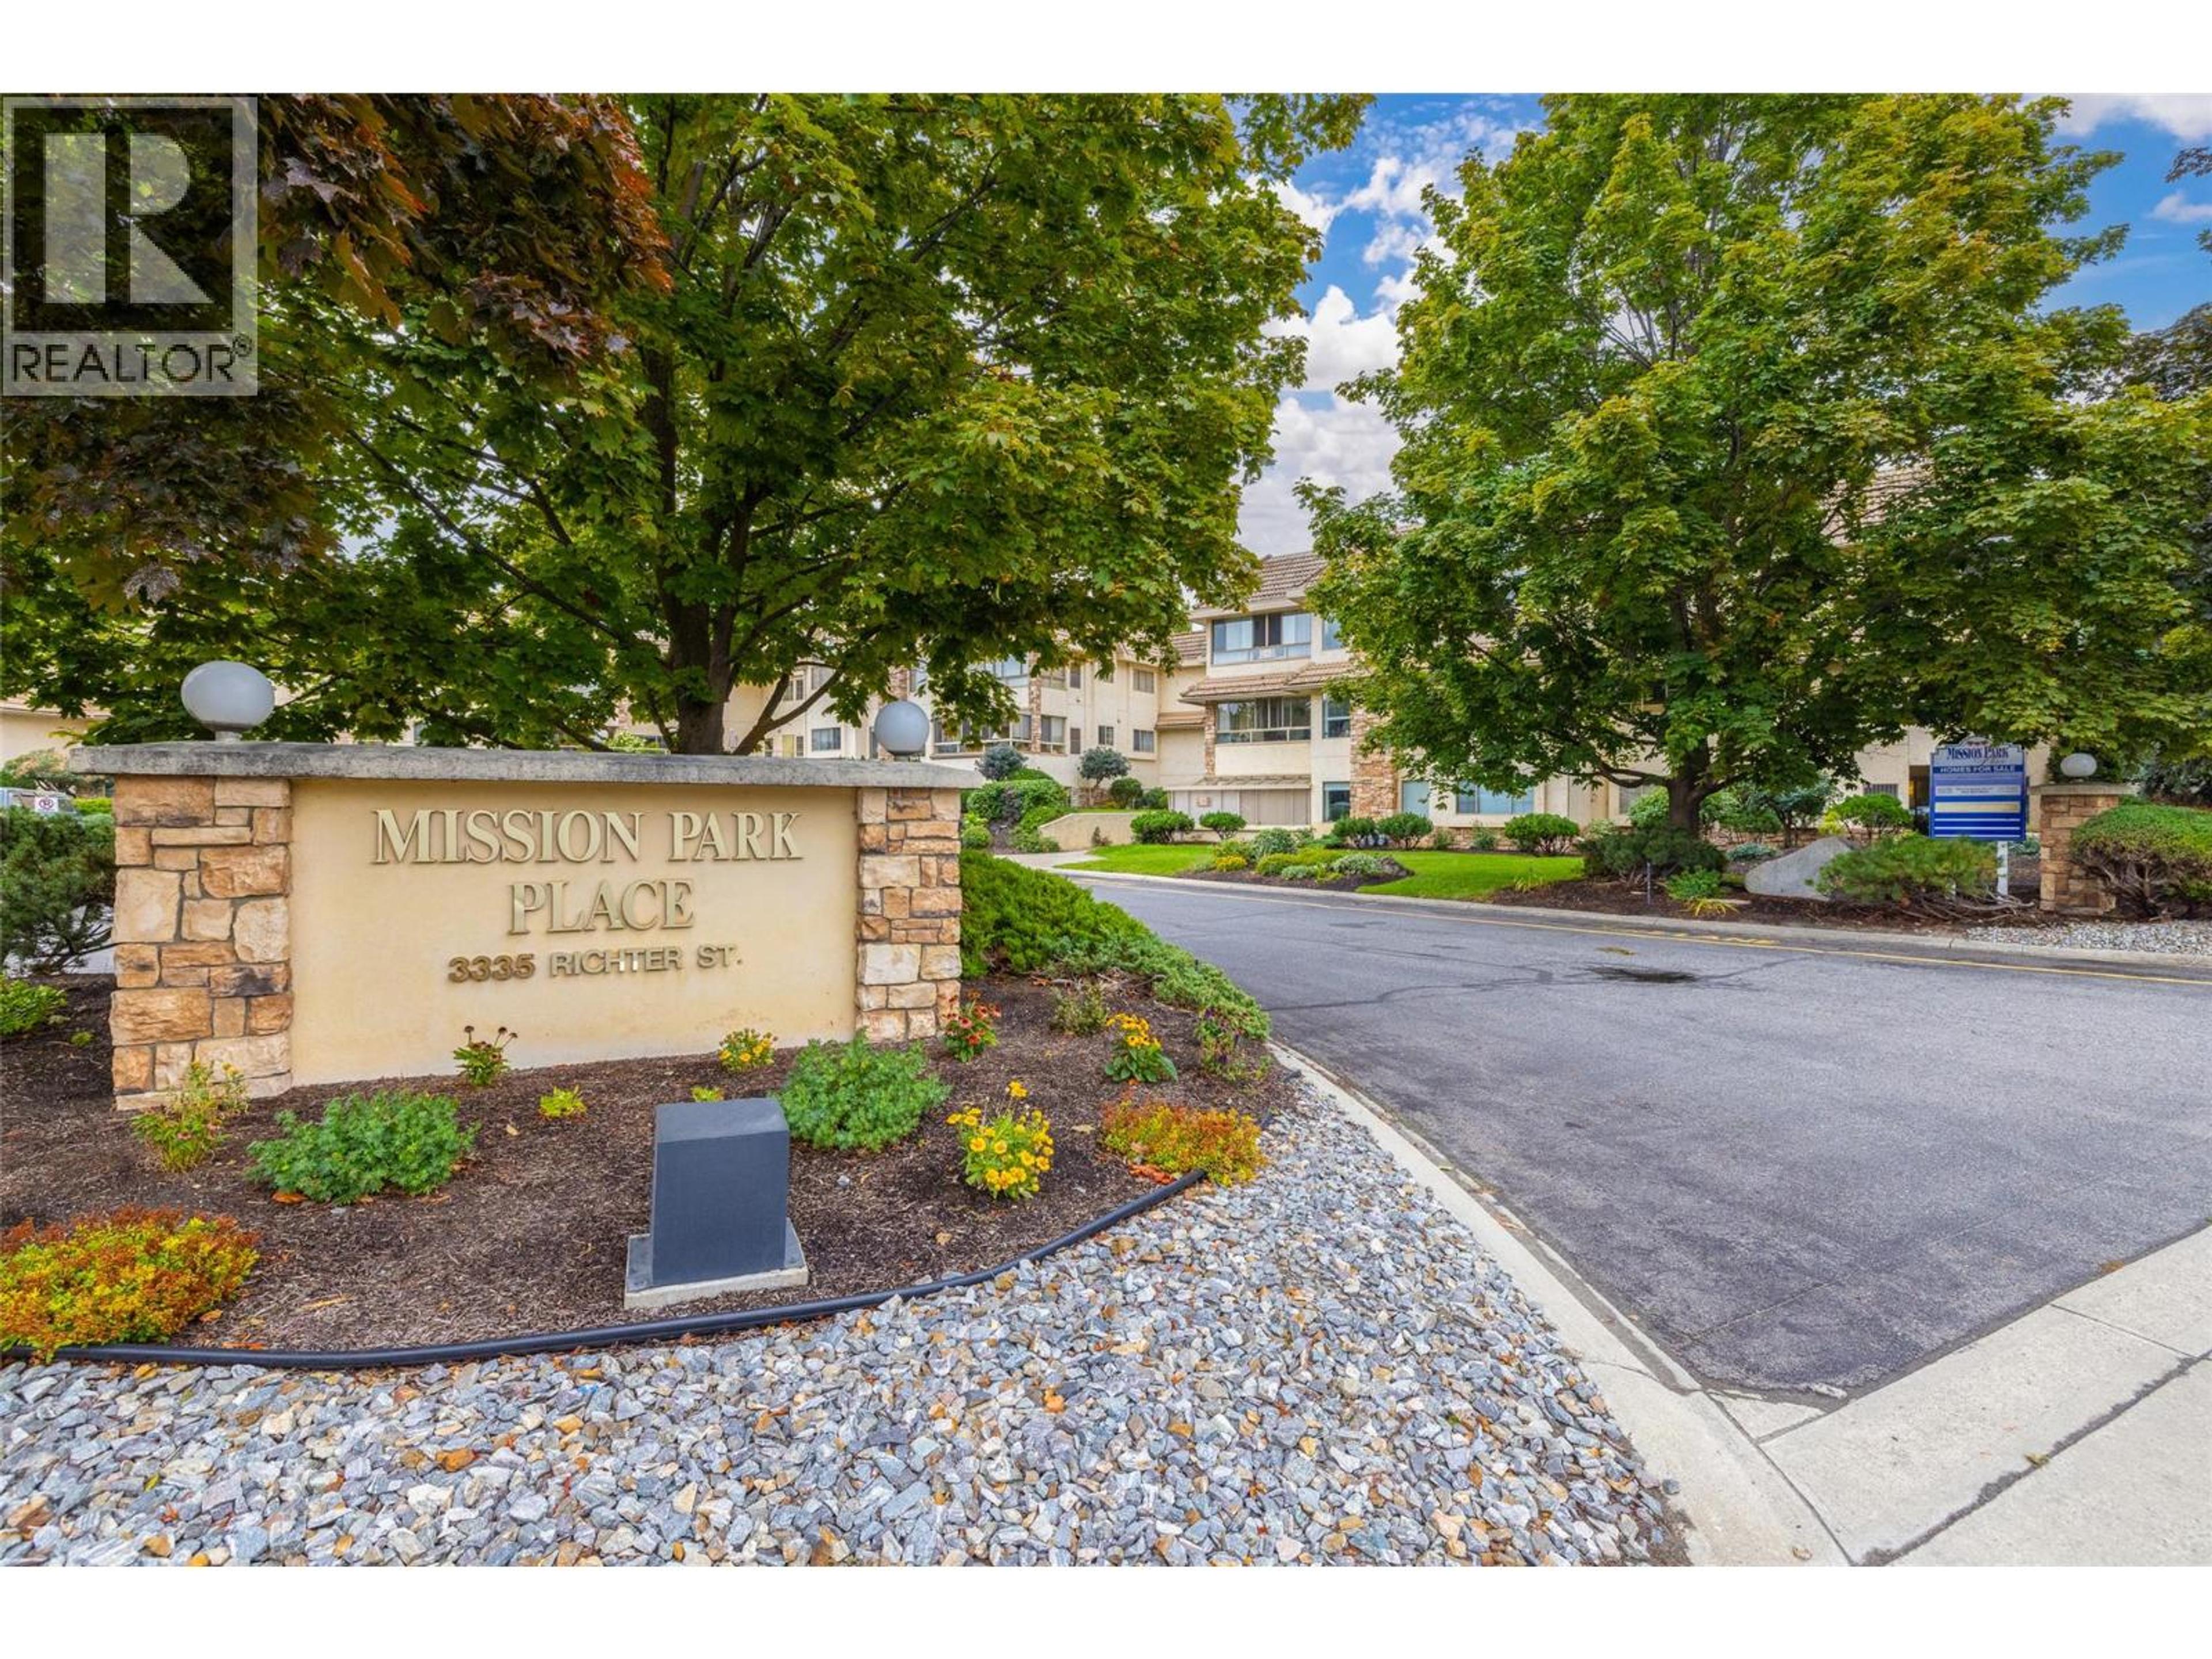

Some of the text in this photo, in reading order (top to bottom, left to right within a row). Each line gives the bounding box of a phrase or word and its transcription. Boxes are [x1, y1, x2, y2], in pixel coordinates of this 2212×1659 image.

[1947, 747, 2009, 759] MISSION PARK
[371, 809, 804, 864] MISSION PARK
[507, 877, 695, 935] PLACE
[448, 943, 743, 983] 3335 RICHTER ST.
